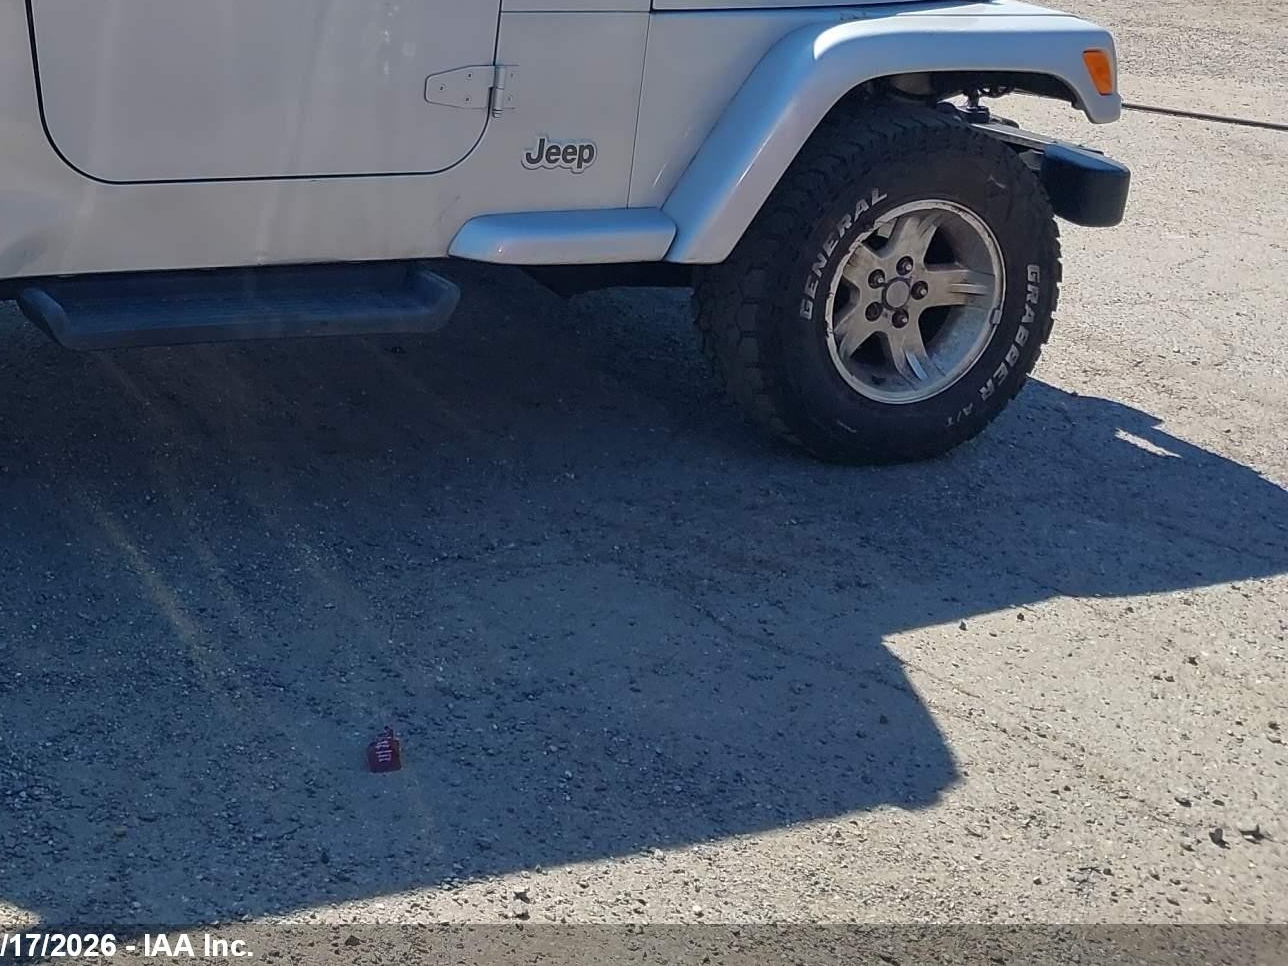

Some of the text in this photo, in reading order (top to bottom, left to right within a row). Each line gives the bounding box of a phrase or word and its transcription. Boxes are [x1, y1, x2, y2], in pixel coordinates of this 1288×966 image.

[525, 137, 596, 170] Jeep
[799, 187, 888, 321] GENERAL
[978, 263, 1041, 402] GRABBER
